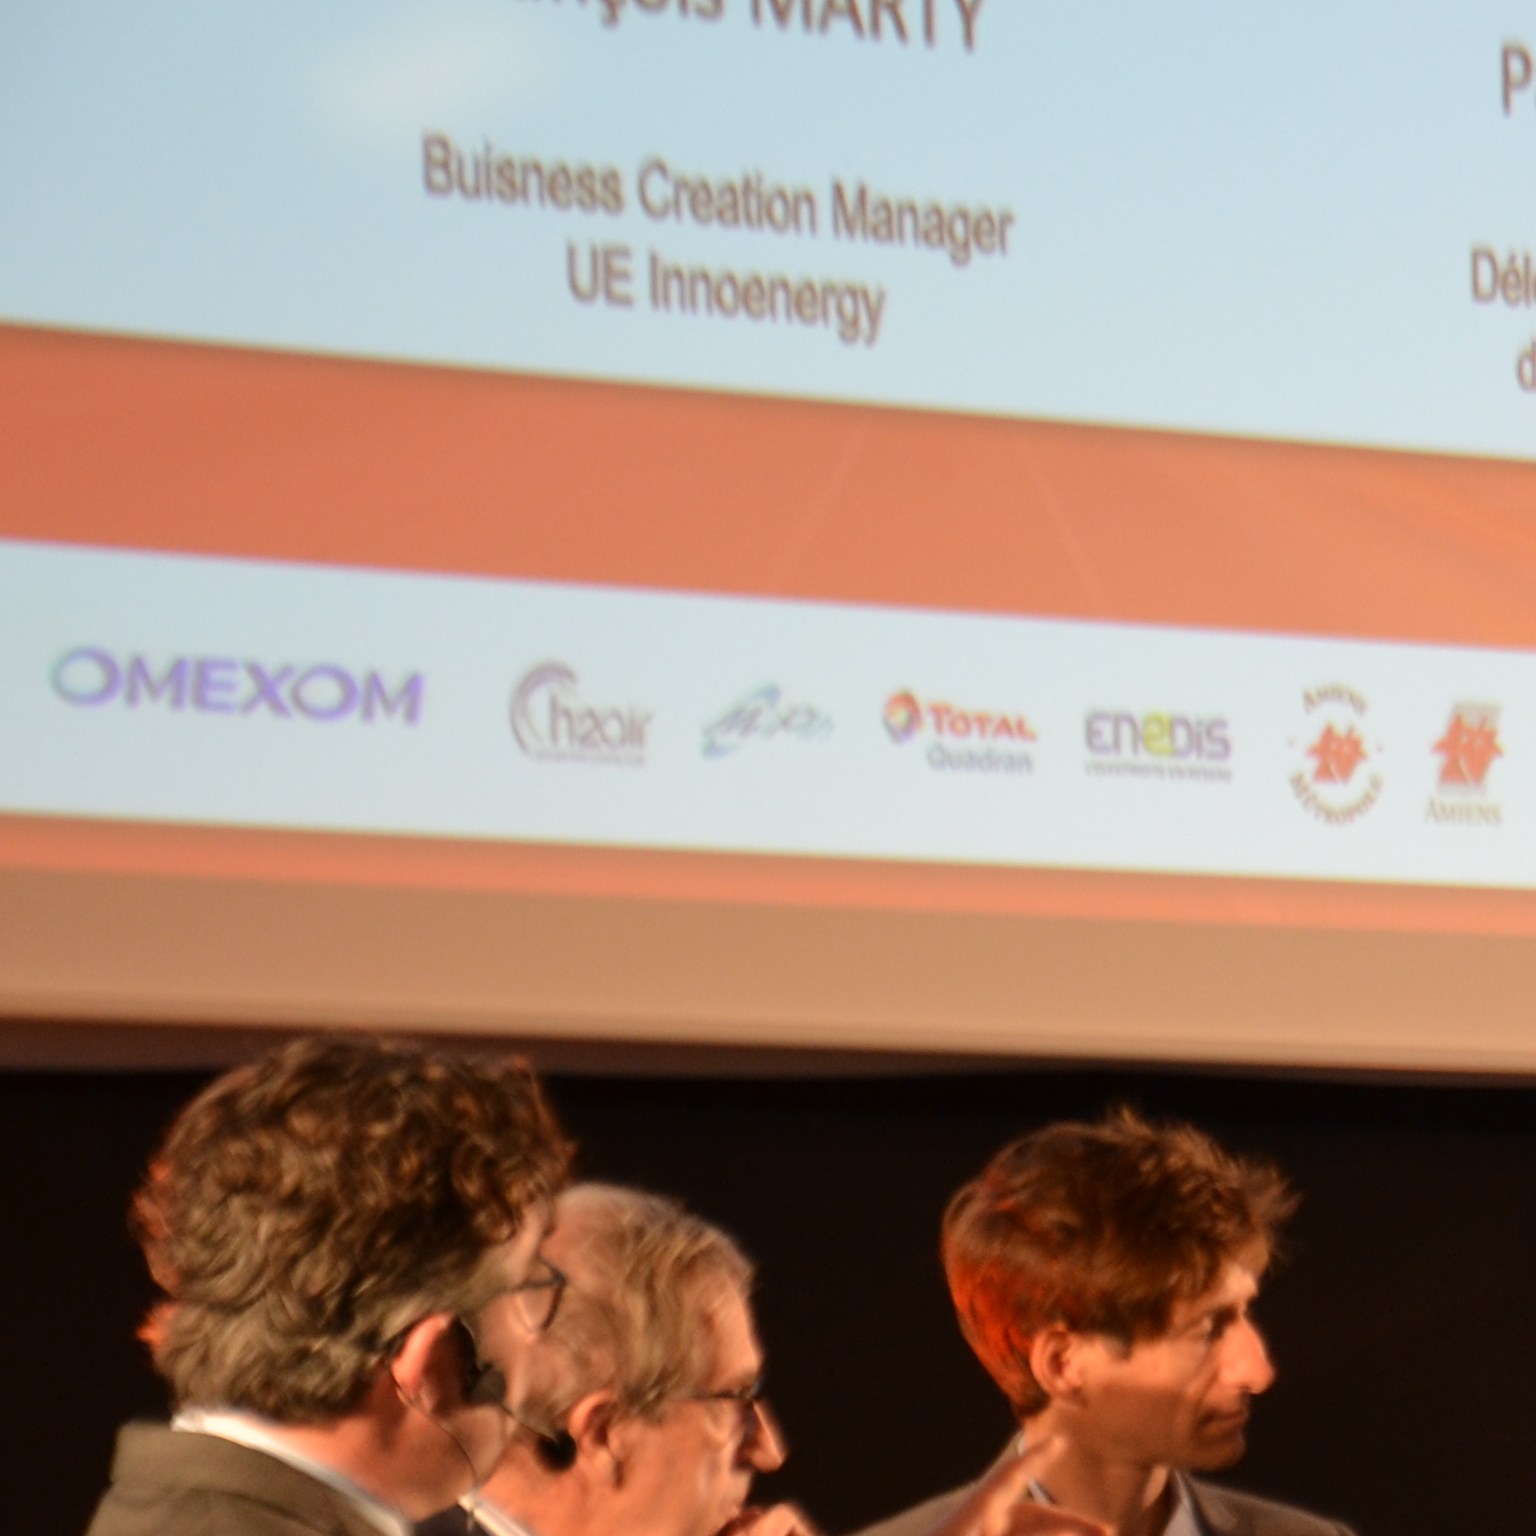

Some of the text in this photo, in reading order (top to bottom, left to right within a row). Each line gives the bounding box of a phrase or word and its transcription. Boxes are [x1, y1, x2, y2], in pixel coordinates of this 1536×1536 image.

[422, 131, 1014, 267] Buisness Creation Manager
[566, 240, 885, 347] UE Innoenergy
[50, 645, 426, 727] OMEXOM
[929, 701, 1038, 742] TOTAL
[927, 742, 1033, 775] Quadran
